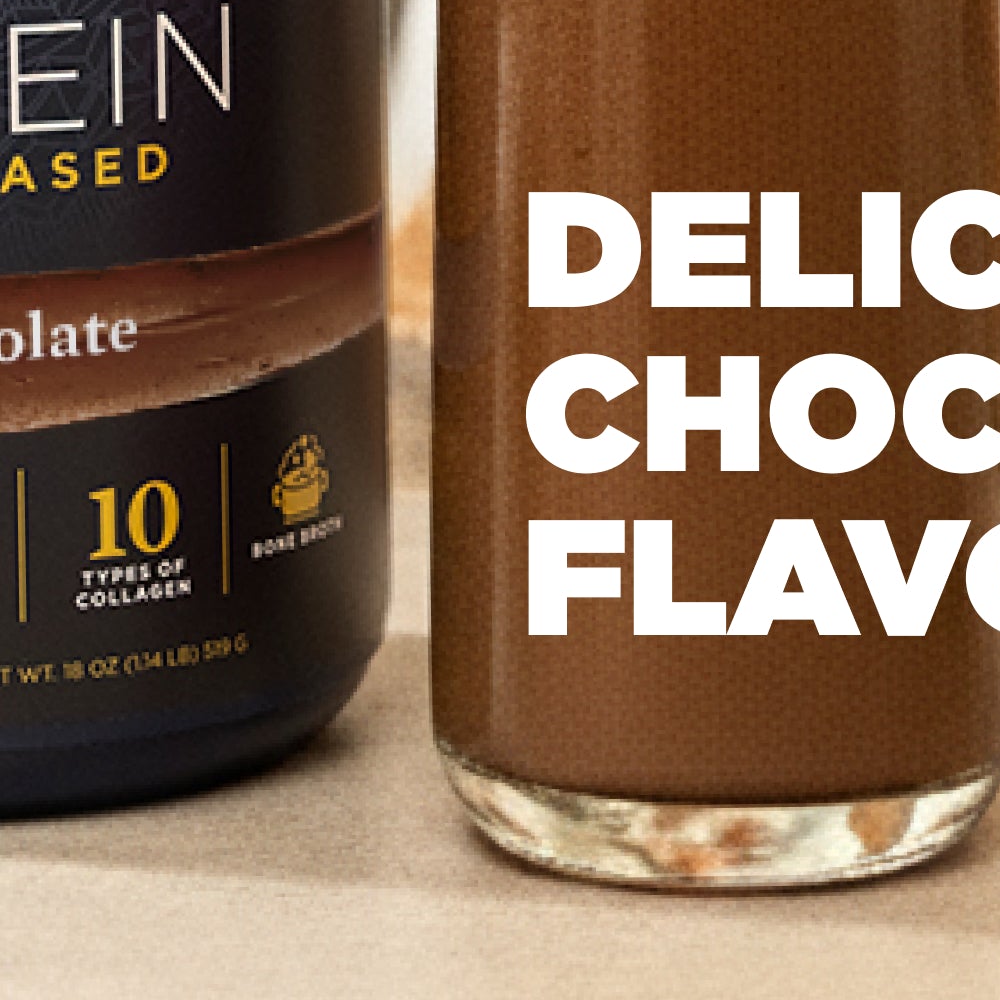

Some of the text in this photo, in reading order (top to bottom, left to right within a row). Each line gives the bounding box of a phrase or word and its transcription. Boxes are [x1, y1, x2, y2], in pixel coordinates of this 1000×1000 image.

[8, 2, 231, 135] EIN
[0, 143, 169, 193] ASED
[0, 308, 138, 363] olate
[88, 479, 181, 561] 10
[75, 579, 192, 611] COLLAGEN
[81, 557, 185, 587] TYPES OF
[88, 655, 120, 679] OZ
